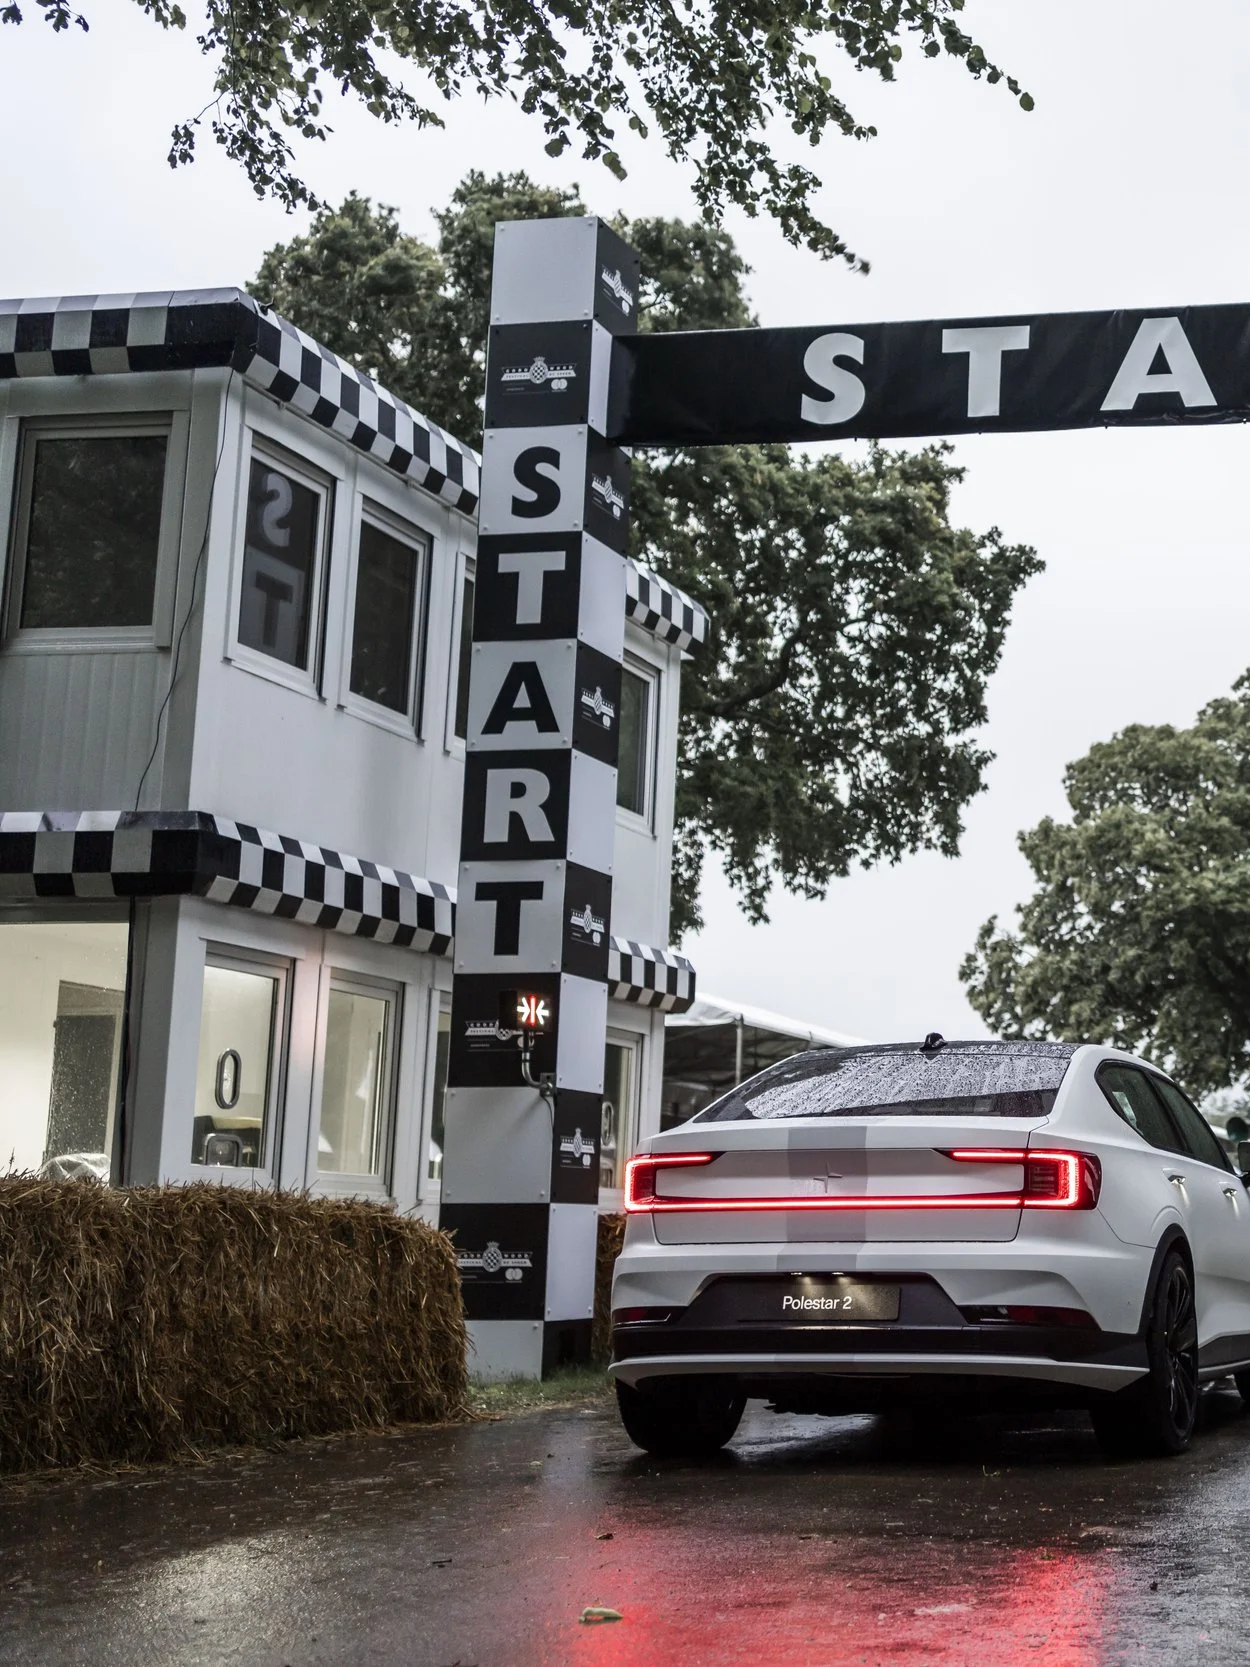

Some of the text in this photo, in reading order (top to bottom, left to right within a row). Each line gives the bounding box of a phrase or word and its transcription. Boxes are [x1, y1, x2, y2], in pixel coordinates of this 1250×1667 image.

[474, 445, 566, 957] START
[782, 1295, 853, 1311] Polestar 2
